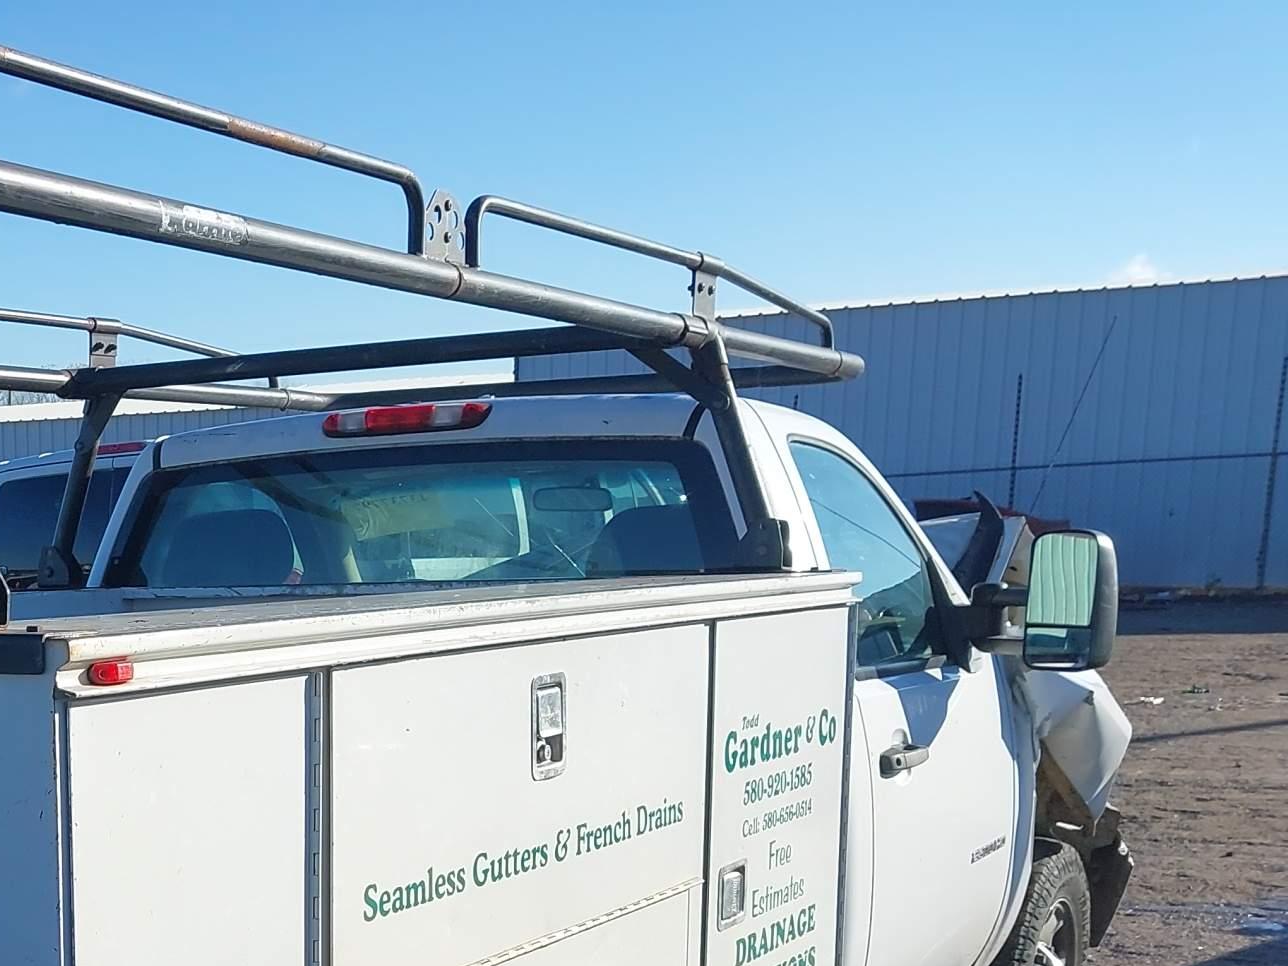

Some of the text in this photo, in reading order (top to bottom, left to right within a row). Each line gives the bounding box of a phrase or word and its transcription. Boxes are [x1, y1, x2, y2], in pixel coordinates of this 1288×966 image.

[724, 708, 837, 773] Gardner & Co
[742, 713, 760, 730] Todd
[743, 762, 813, 806] 580-920-1585
[742, 798, 813, 837] Cell: 580-656-0514
[363, 798, 684, 922] Seamless Gutters & French Drains
[768, 840, 792, 870] Free
[752, 875, 805, 918] Estimates
